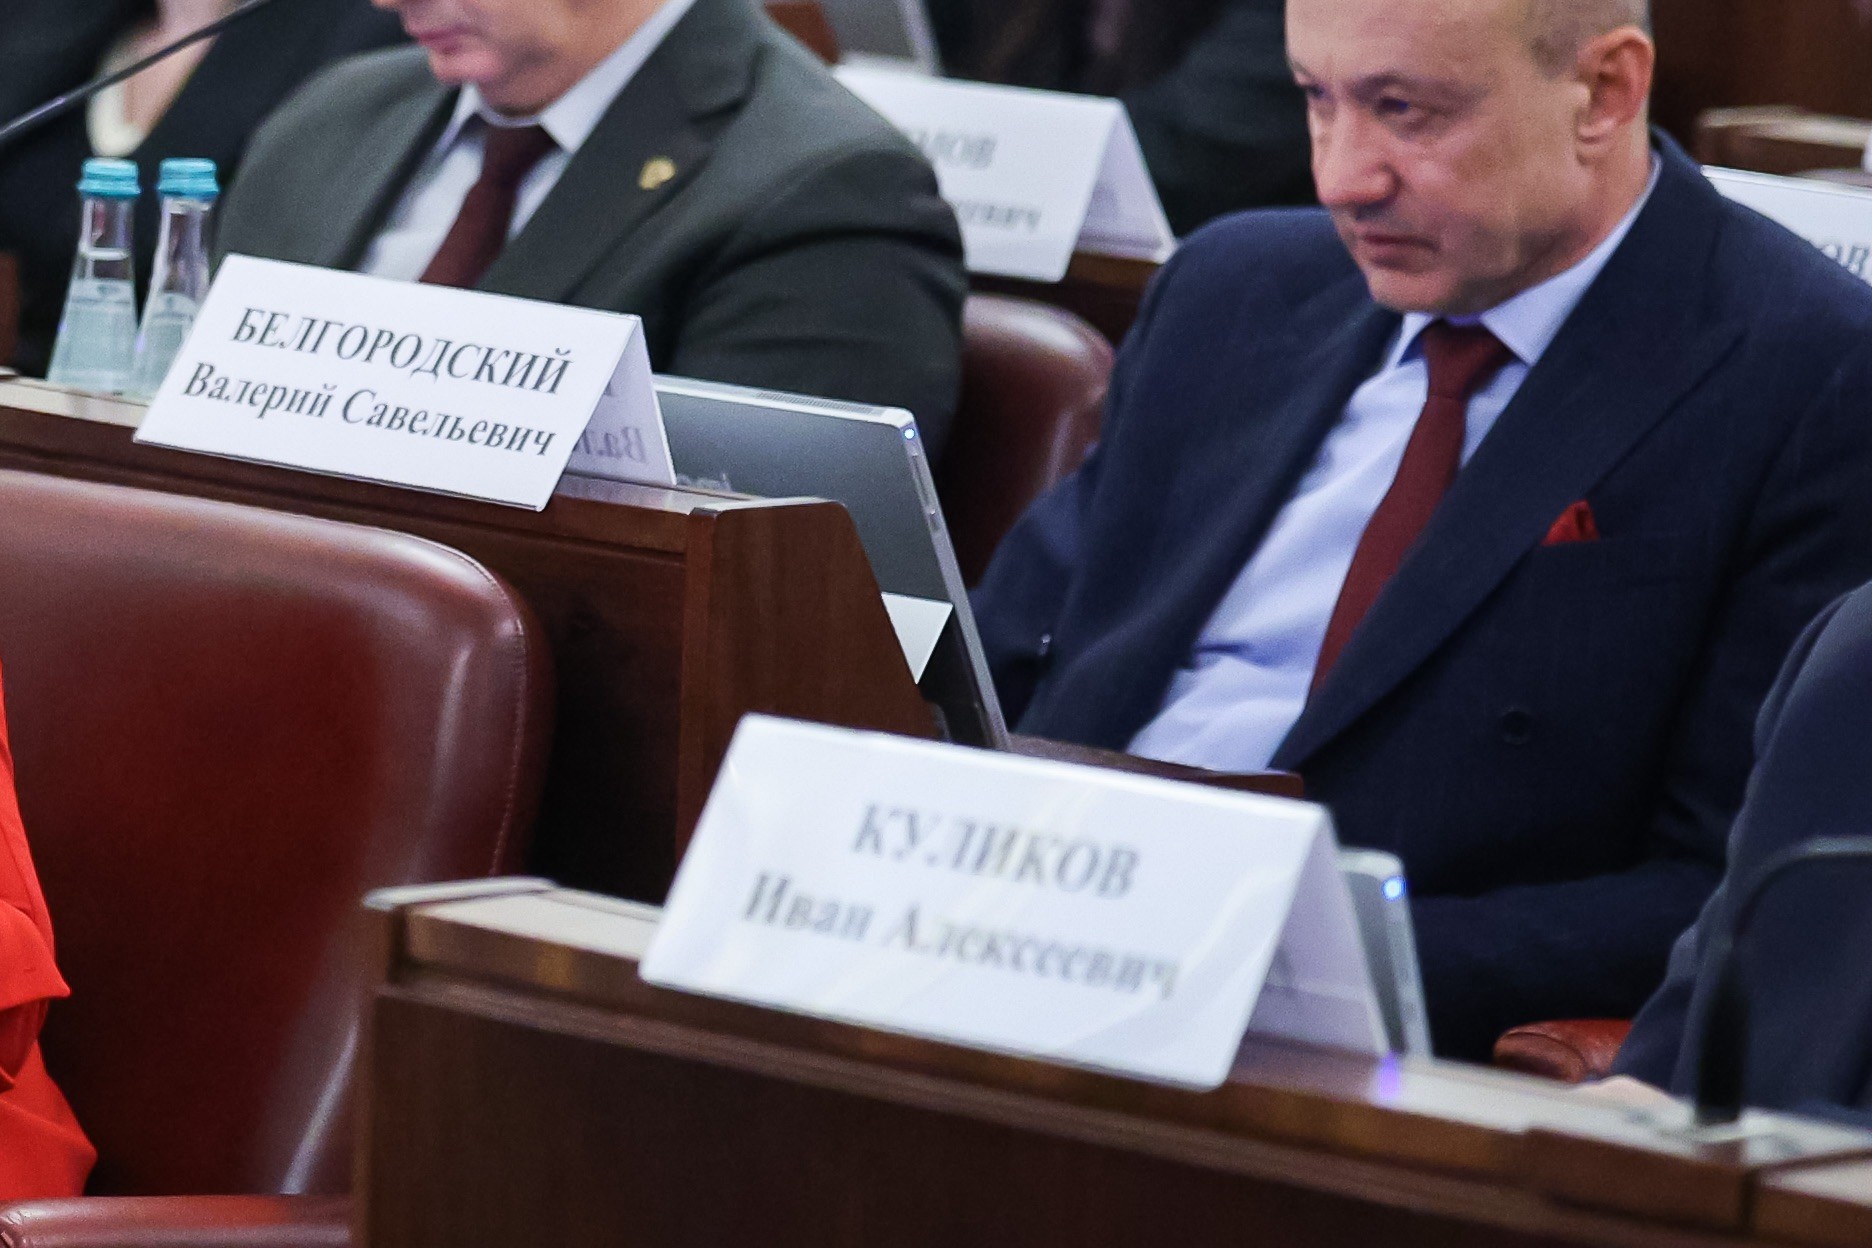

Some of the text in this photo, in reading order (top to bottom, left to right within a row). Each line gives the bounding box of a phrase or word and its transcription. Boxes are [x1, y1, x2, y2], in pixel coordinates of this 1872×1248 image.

[230, 306, 573, 395] БЕЛГОРОДСКИЙ
[181, 361, 557, 456] Валерий Савельевич
[850, 802, 1142, 900] КУЛИКОВ
[741, 869, 1181, 1004] Иван Алексеевич
